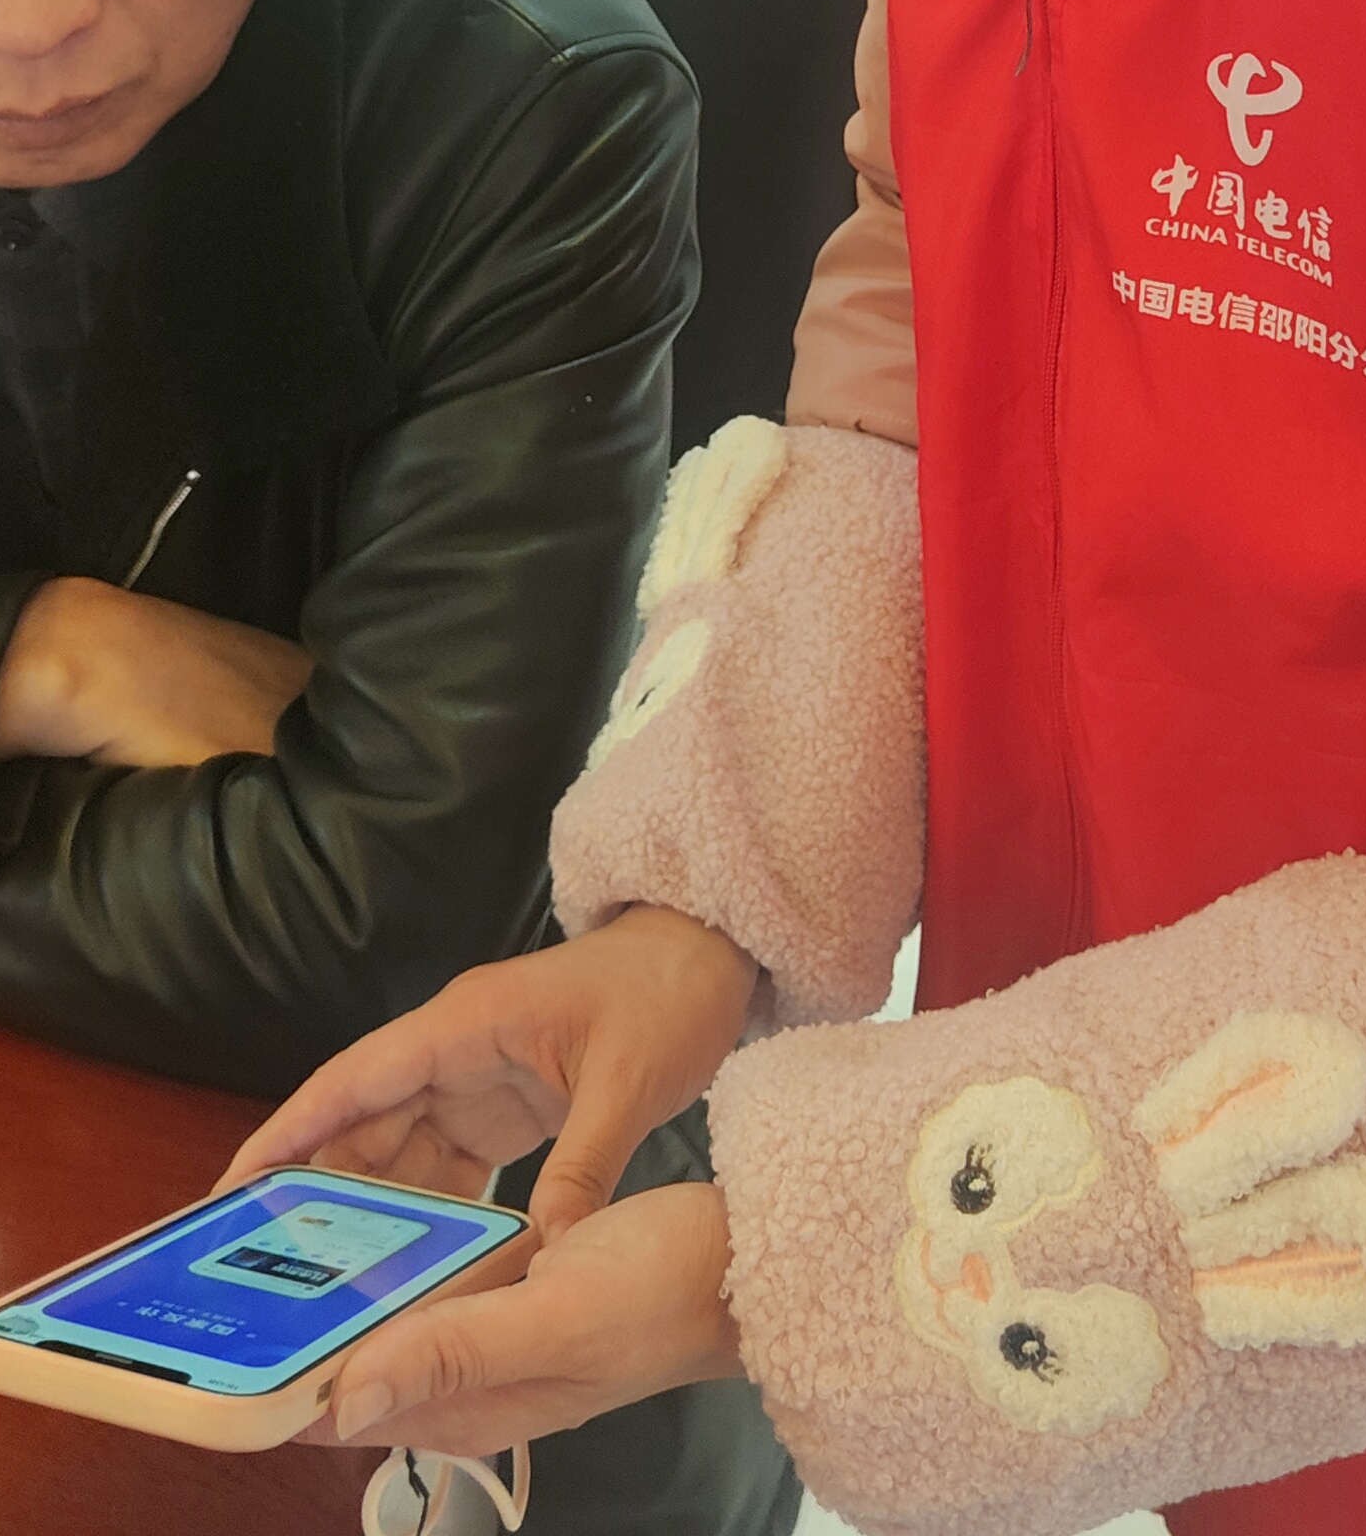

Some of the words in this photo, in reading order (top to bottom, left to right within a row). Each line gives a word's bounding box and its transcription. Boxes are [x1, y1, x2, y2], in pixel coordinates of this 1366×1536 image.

[1151, 154, 1333, 262] 中国电信
[1145, 218, 1228, 246] CHINA
[1235, 232, 1333, 287] TELECOM
